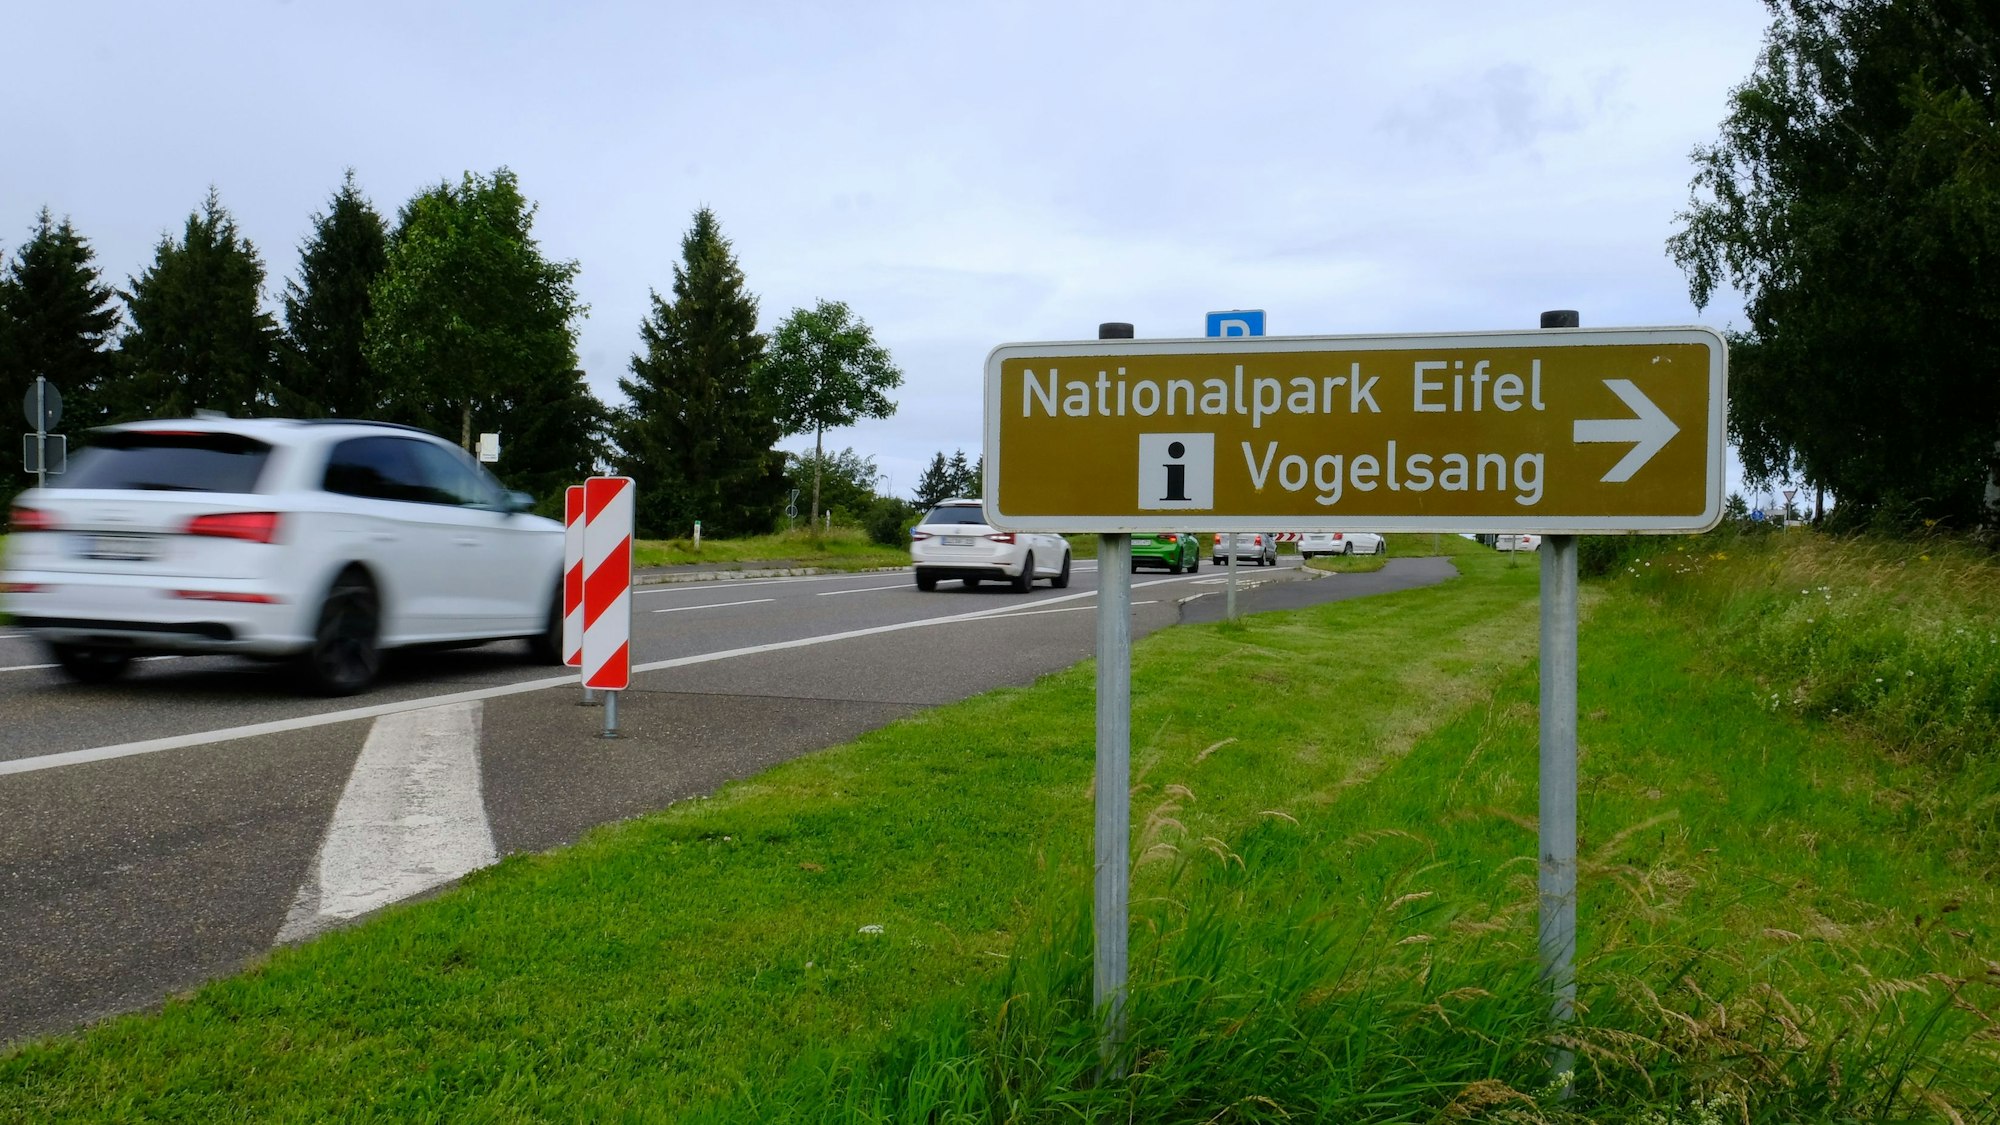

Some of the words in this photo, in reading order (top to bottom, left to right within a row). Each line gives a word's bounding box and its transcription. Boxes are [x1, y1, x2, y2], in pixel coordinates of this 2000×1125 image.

[1022, 360, 1382, 429] Nationalpark
[1412, 357, 1545, 413] Eifel
[1241, 440, 1545, 506] Vogelsang
